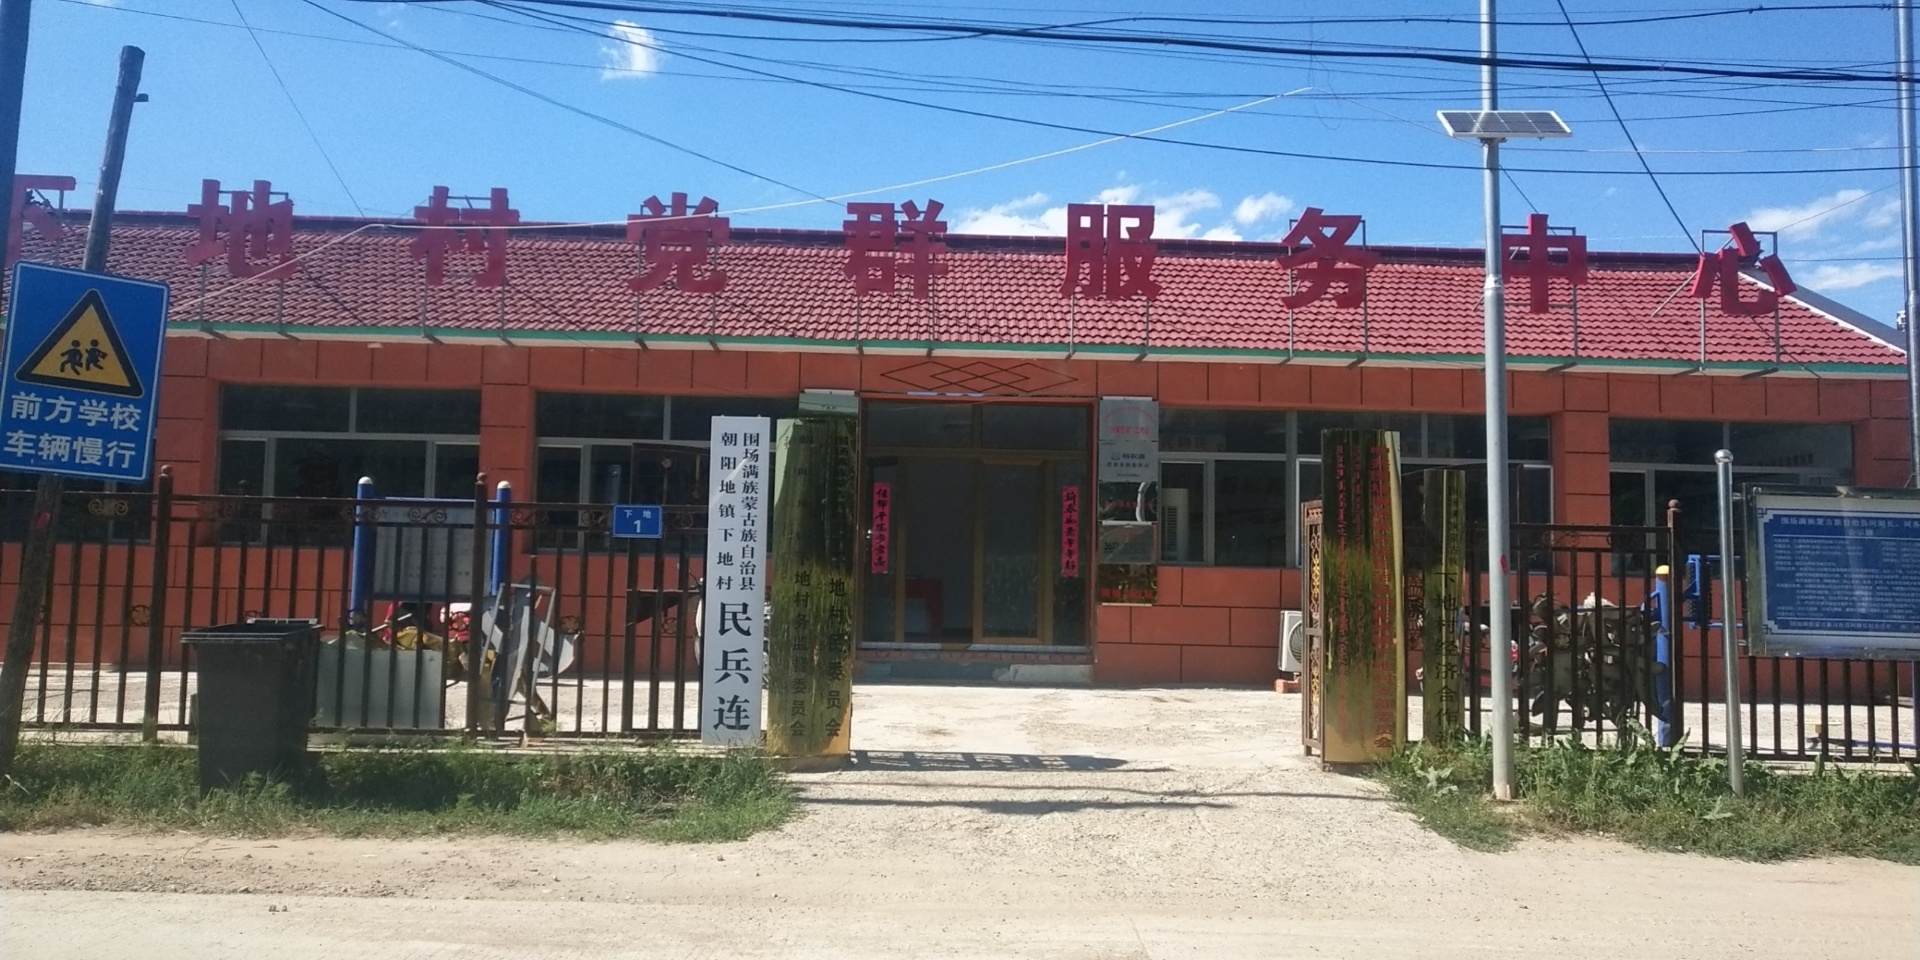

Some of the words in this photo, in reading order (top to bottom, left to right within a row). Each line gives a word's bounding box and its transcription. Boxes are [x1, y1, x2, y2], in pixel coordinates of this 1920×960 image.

[4, 173, 1796, 315] 下地村党群服务中心
[3, 429, 137, 469] 车辆慢行
[10, 390, 142, 433] 前方学校
[623, 509, 652, 519] 下地
[633, 519, 642, 533] 1
[715, 431, 738, 591] 朝阳地镇下地村
[738, 431, 761, 592] 围场满族蒙古族自治县
[712, 601, 754, 732] 民兵连
